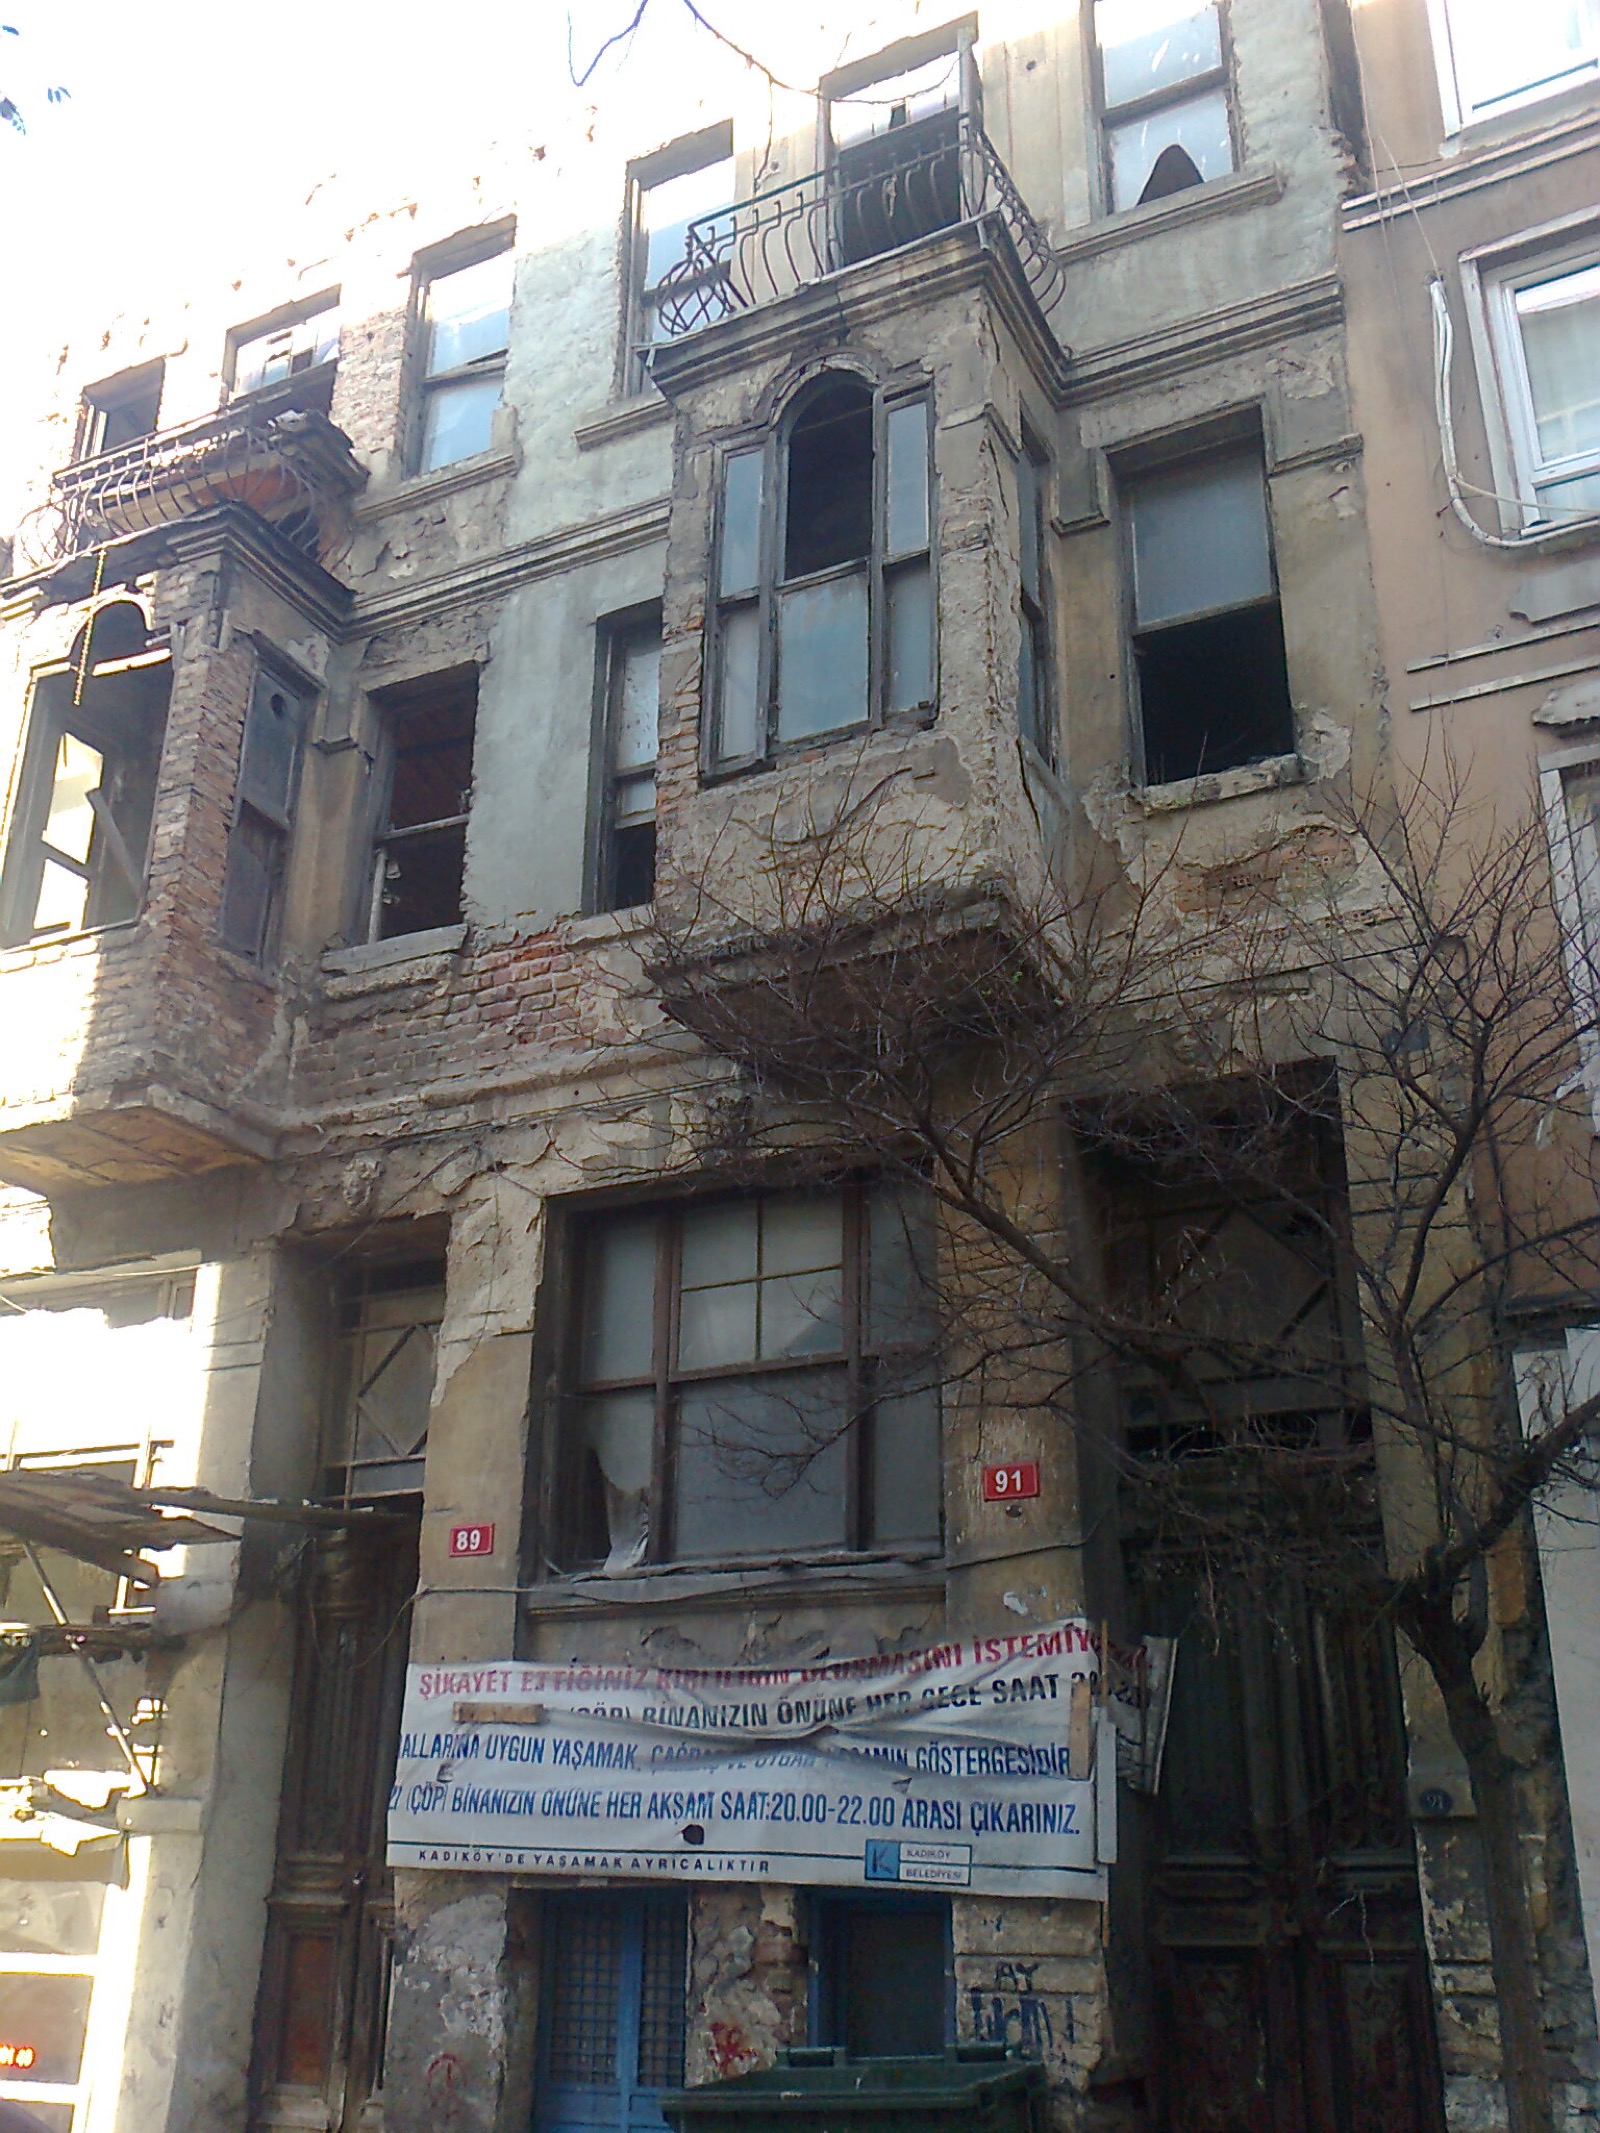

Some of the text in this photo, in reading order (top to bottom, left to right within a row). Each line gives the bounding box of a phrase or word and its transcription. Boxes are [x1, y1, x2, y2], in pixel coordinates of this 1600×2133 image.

[995, 1469, 1022, 1493] 91
[456, 1529, 481, 1551] 89
[419, 1667, 512, 1700] ŞİKAYET
[521, 1663, 648, 1693] ETTİĞİNİZ
[641, 1701, 768, 1729] BİNANIZIN
[991, 1673, 1059, 1703] SAAT
[398, 1733, 480, 1759] ALLARINA
[485, 1734, 546, 1764] UYGUN
[451, 1782, 537, 1816] BİNANIZIN
[606, 1790, 643, 1819] HER
[646, 1790, 716, 1826] AKŞAM
[901, 1798, 962, 1831] ARASI
[969, 1801, 1081, 1837] ÇIKARINIZ.
[418, 1848, 526, 1866] KADIKÖY'DE
[871, 1846, 894, 1875] K
